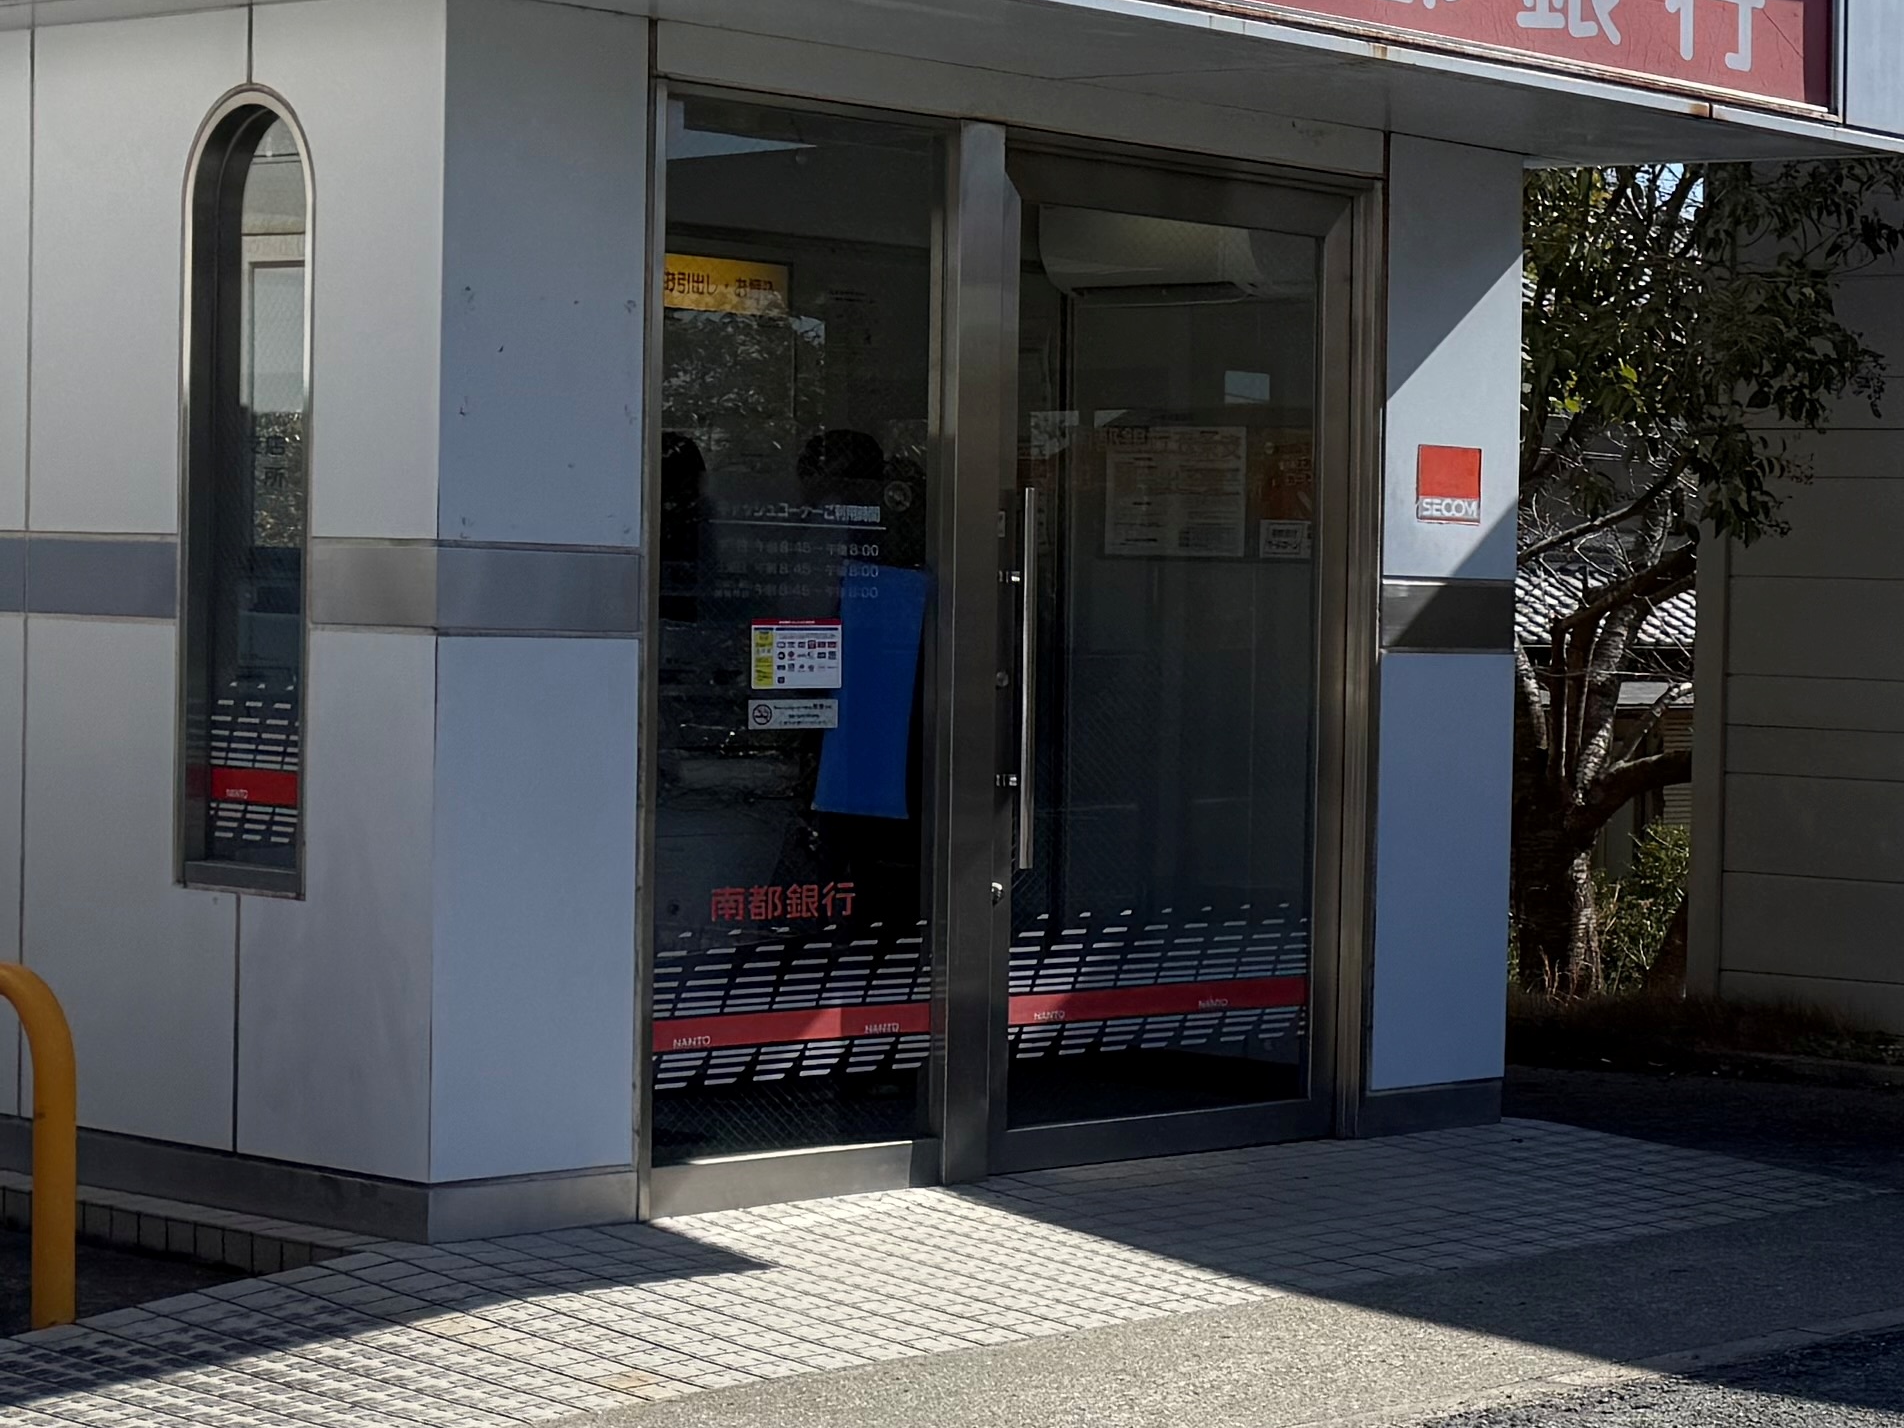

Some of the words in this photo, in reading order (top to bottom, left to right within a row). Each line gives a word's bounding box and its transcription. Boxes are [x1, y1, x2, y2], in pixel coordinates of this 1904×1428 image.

[1422, 498, 1478, 518] SECOM
[711, 882, 856, 921] 南都銀行
[673, 1035, 711, 1049] NANTO
